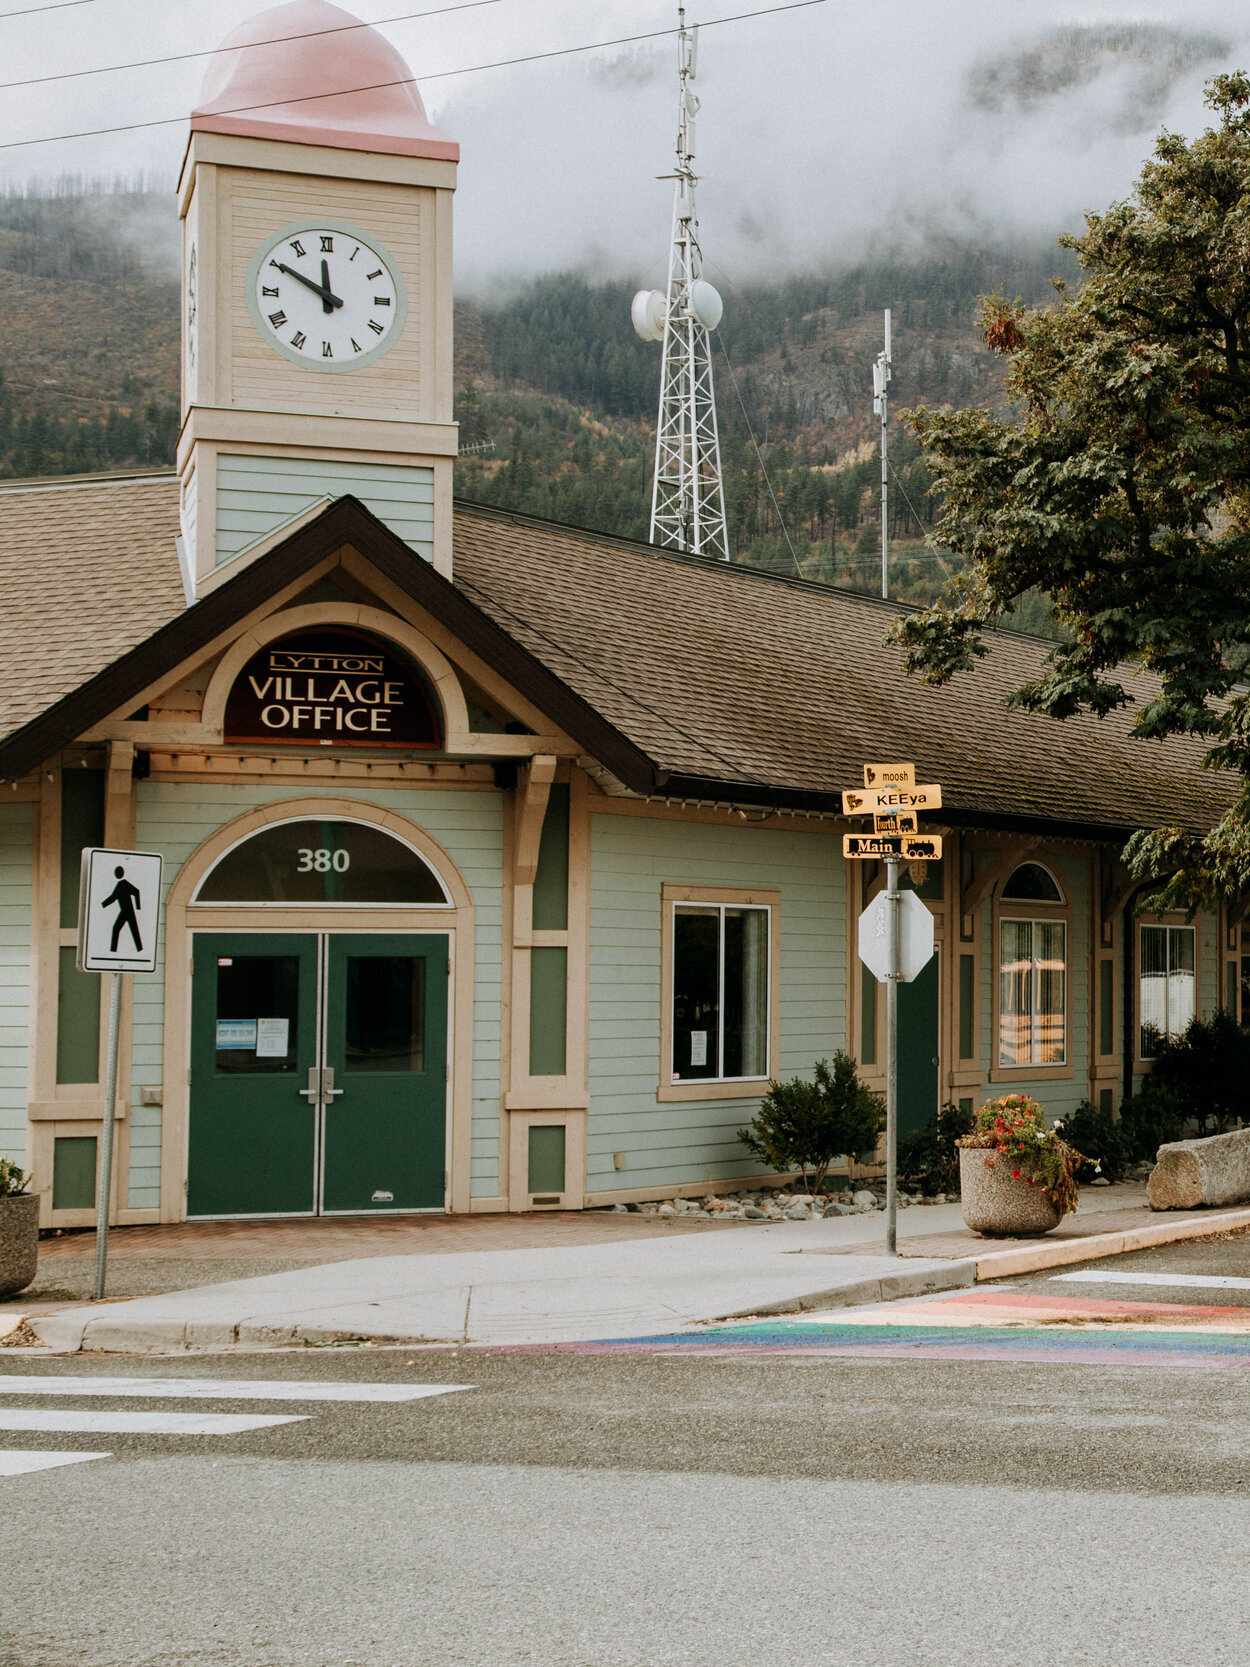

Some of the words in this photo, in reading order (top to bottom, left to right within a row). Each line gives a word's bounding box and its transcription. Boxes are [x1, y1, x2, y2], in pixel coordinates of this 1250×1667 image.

[290, 240, 306, 257] XI
[320, 236, 334, 252] XII
[349, 247, 360, 261] I
[366, 269, 383, 280] II
[262, 286, 279, 297] IX
[374, 296, 390, 306] III
[268, 310, 288, 329] VIII
[367, 319, 384, 335] IV
[290, 331, 306, 349] VII
[350, 338, 362, 352] V
[322, 341, 333, 357] VI
[270, 655, 384, 672] LYTTON
[248, 675, 404, 705] VILLAGE
[261, 704, 392, 732] OFFICE
[882, 771, 909, 781] moosh
[876, 793, 927, 806] KEEya
[857, 839, 893, 853] Main
[297, 848, 350, 873] 380
